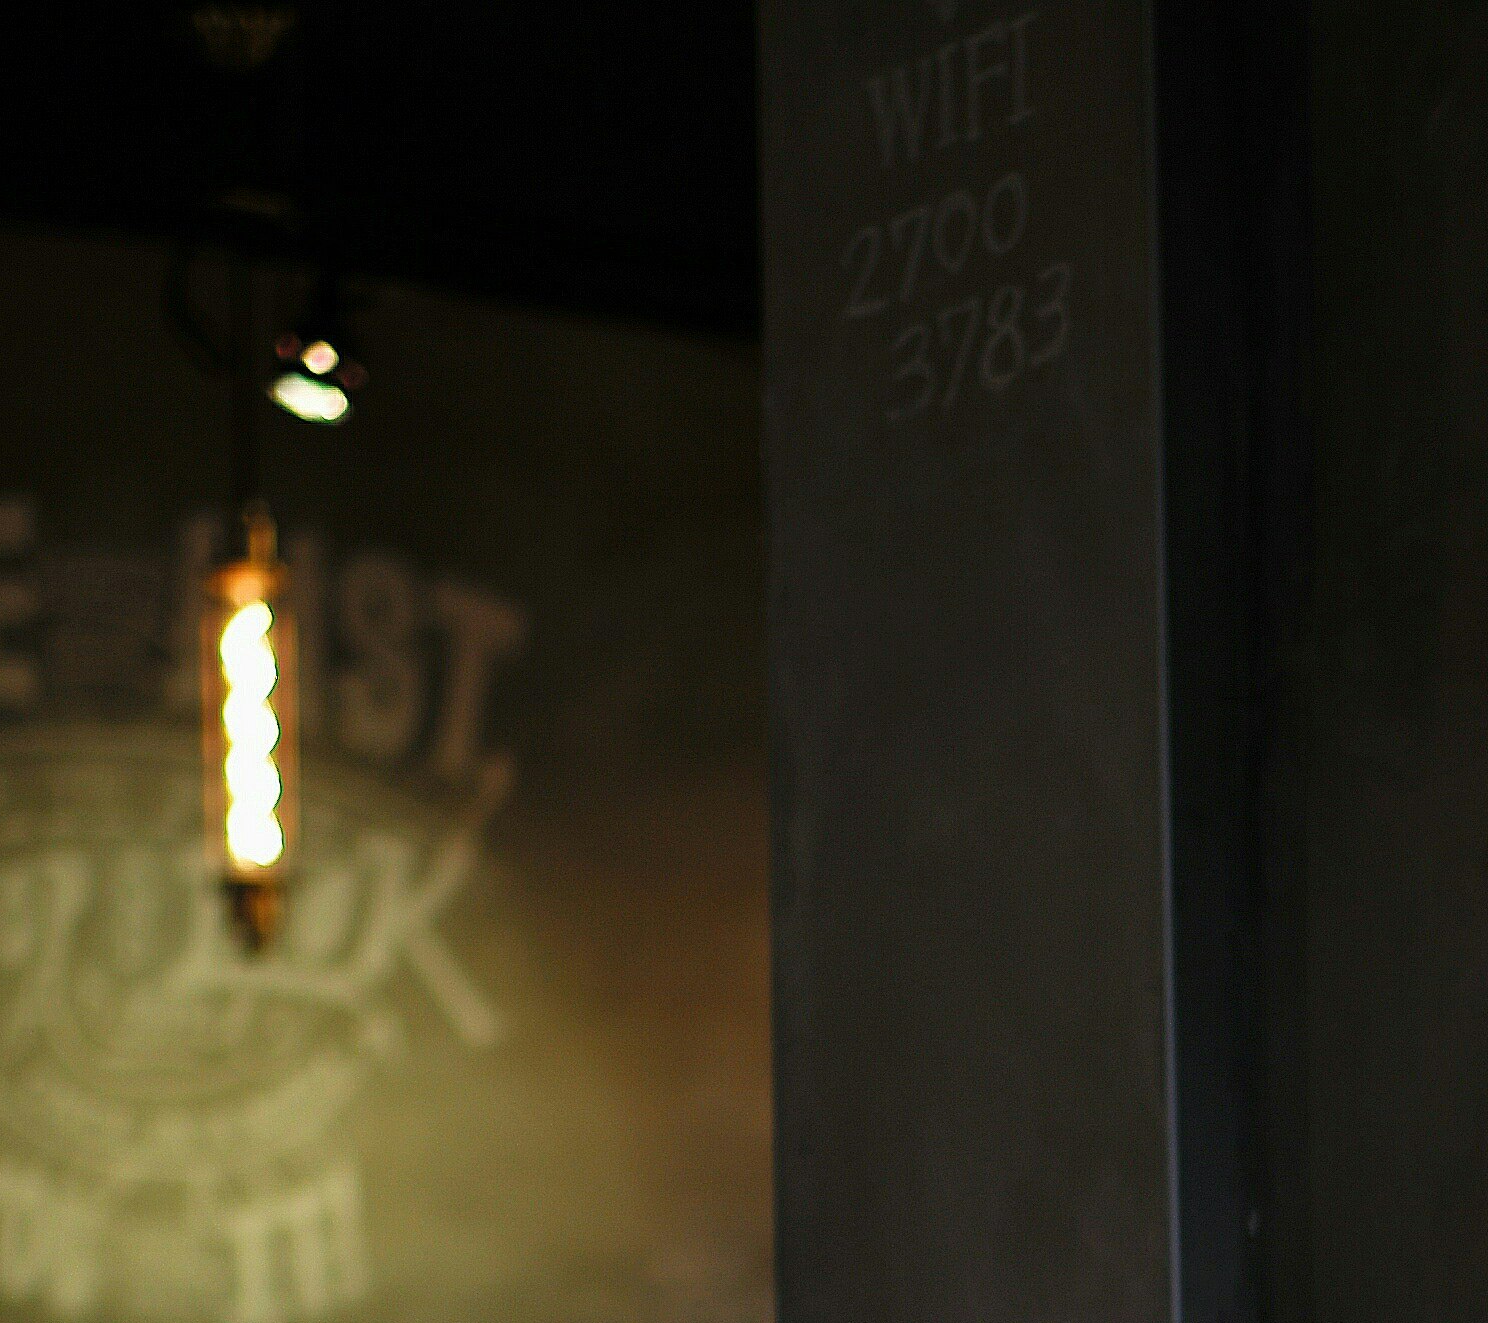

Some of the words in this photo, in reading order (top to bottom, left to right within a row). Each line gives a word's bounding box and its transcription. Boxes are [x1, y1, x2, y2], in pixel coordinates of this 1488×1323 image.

[864, 12, 1039, 168] WIFI
[838, 170, 1029, 323] 2700
[883, 258, 1076, 427] 3783
